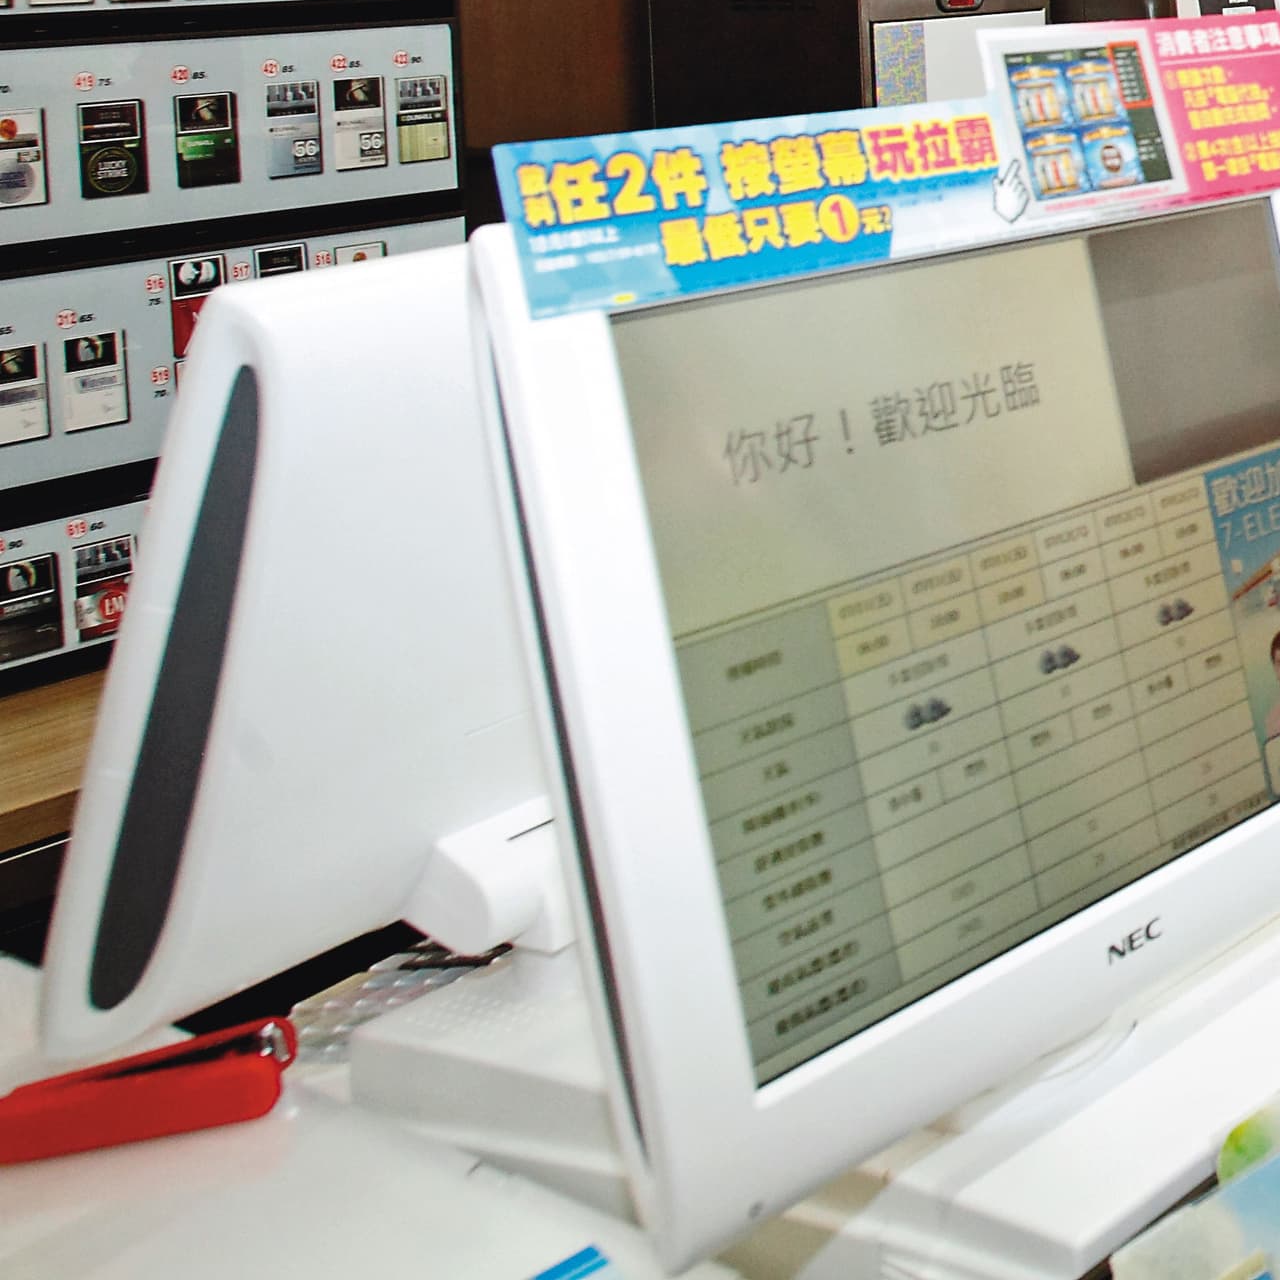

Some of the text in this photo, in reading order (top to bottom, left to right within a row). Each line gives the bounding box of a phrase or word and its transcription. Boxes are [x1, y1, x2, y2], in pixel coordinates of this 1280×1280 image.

[294, 140, 318, 157] 56
[360, 133, 383, 151] 56
[97, 160, 128, 172] LUCKY
[1106, 916, 1164, 967] NEC
